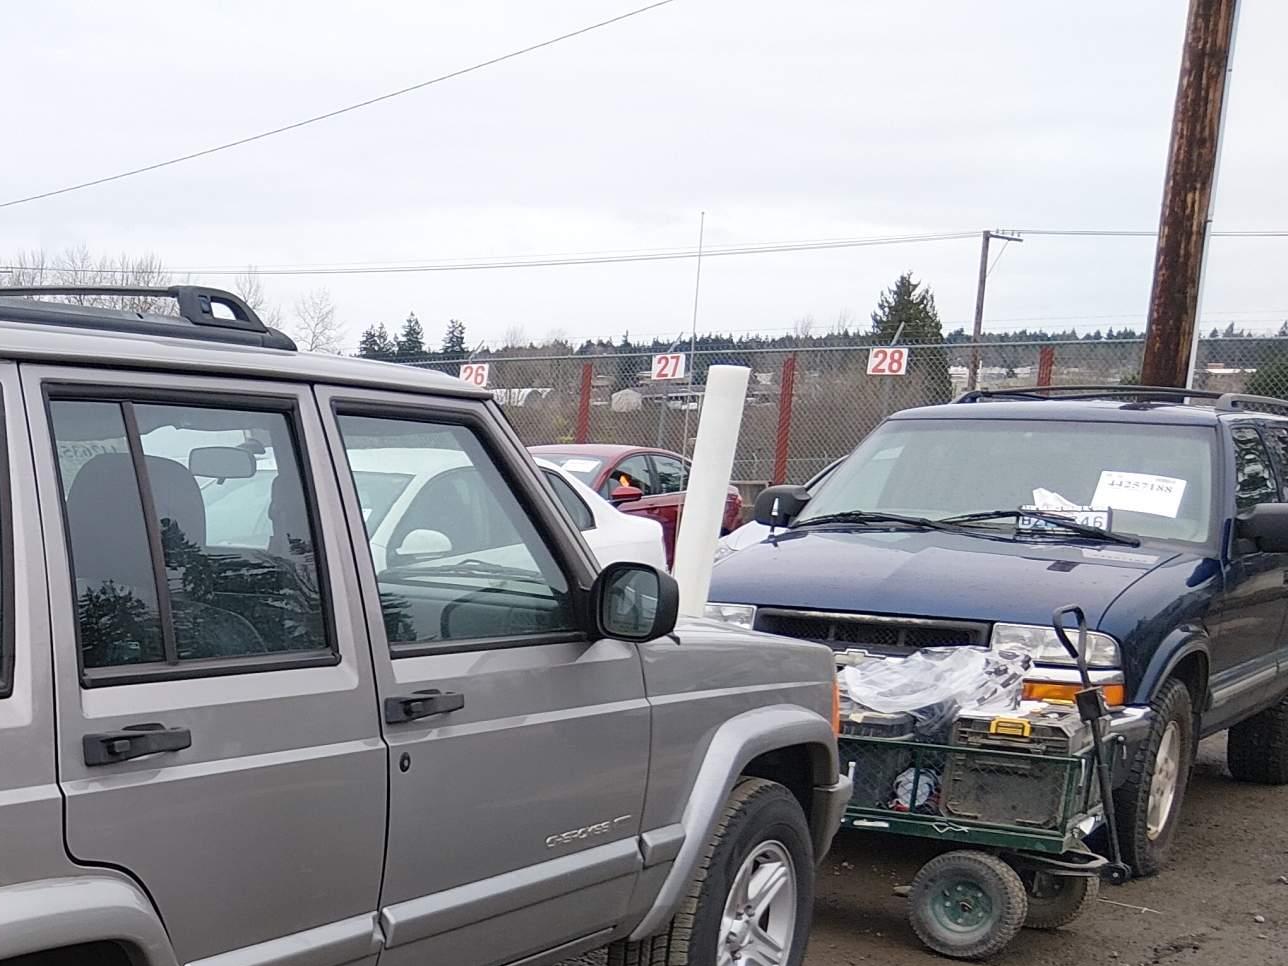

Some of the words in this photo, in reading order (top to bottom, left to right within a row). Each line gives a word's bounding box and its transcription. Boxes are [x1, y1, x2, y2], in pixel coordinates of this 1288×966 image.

[655, 355, 681, 378] 27
[871, 349, 904, 374] 28
[463, 365, 486, 386] 26
